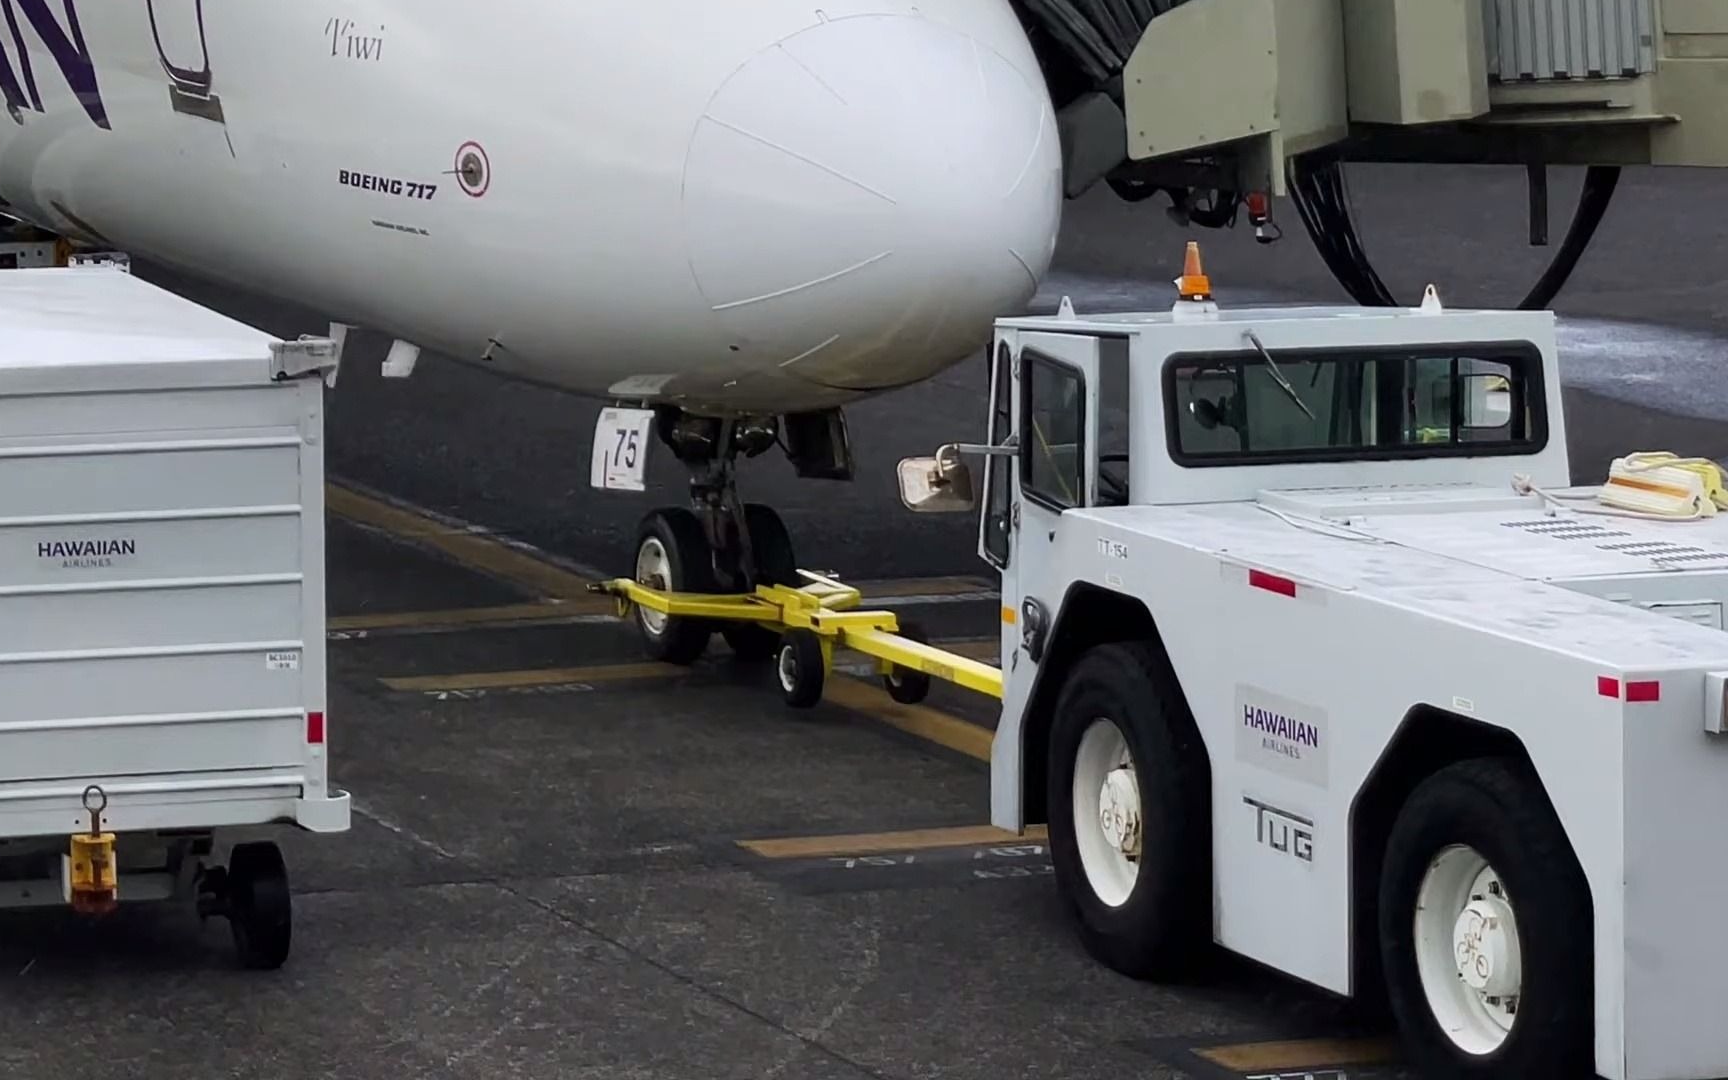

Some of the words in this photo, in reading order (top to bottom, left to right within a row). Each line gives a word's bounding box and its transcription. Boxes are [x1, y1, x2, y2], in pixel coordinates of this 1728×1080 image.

[339, 169, 402, 195] BOEING
[406, 182, 437, 200] 717
[614, 428, 639, 468] 75
[38, 540, 135, 557] HAWAIIAN
[62, 559, 112, 568] AIRLINES
[1244, 704, 1318, 748] HAWAIIAN
[1262, 737, 1301, 759] AIRLINES
[1242, 796, 1314, 862] TUG
